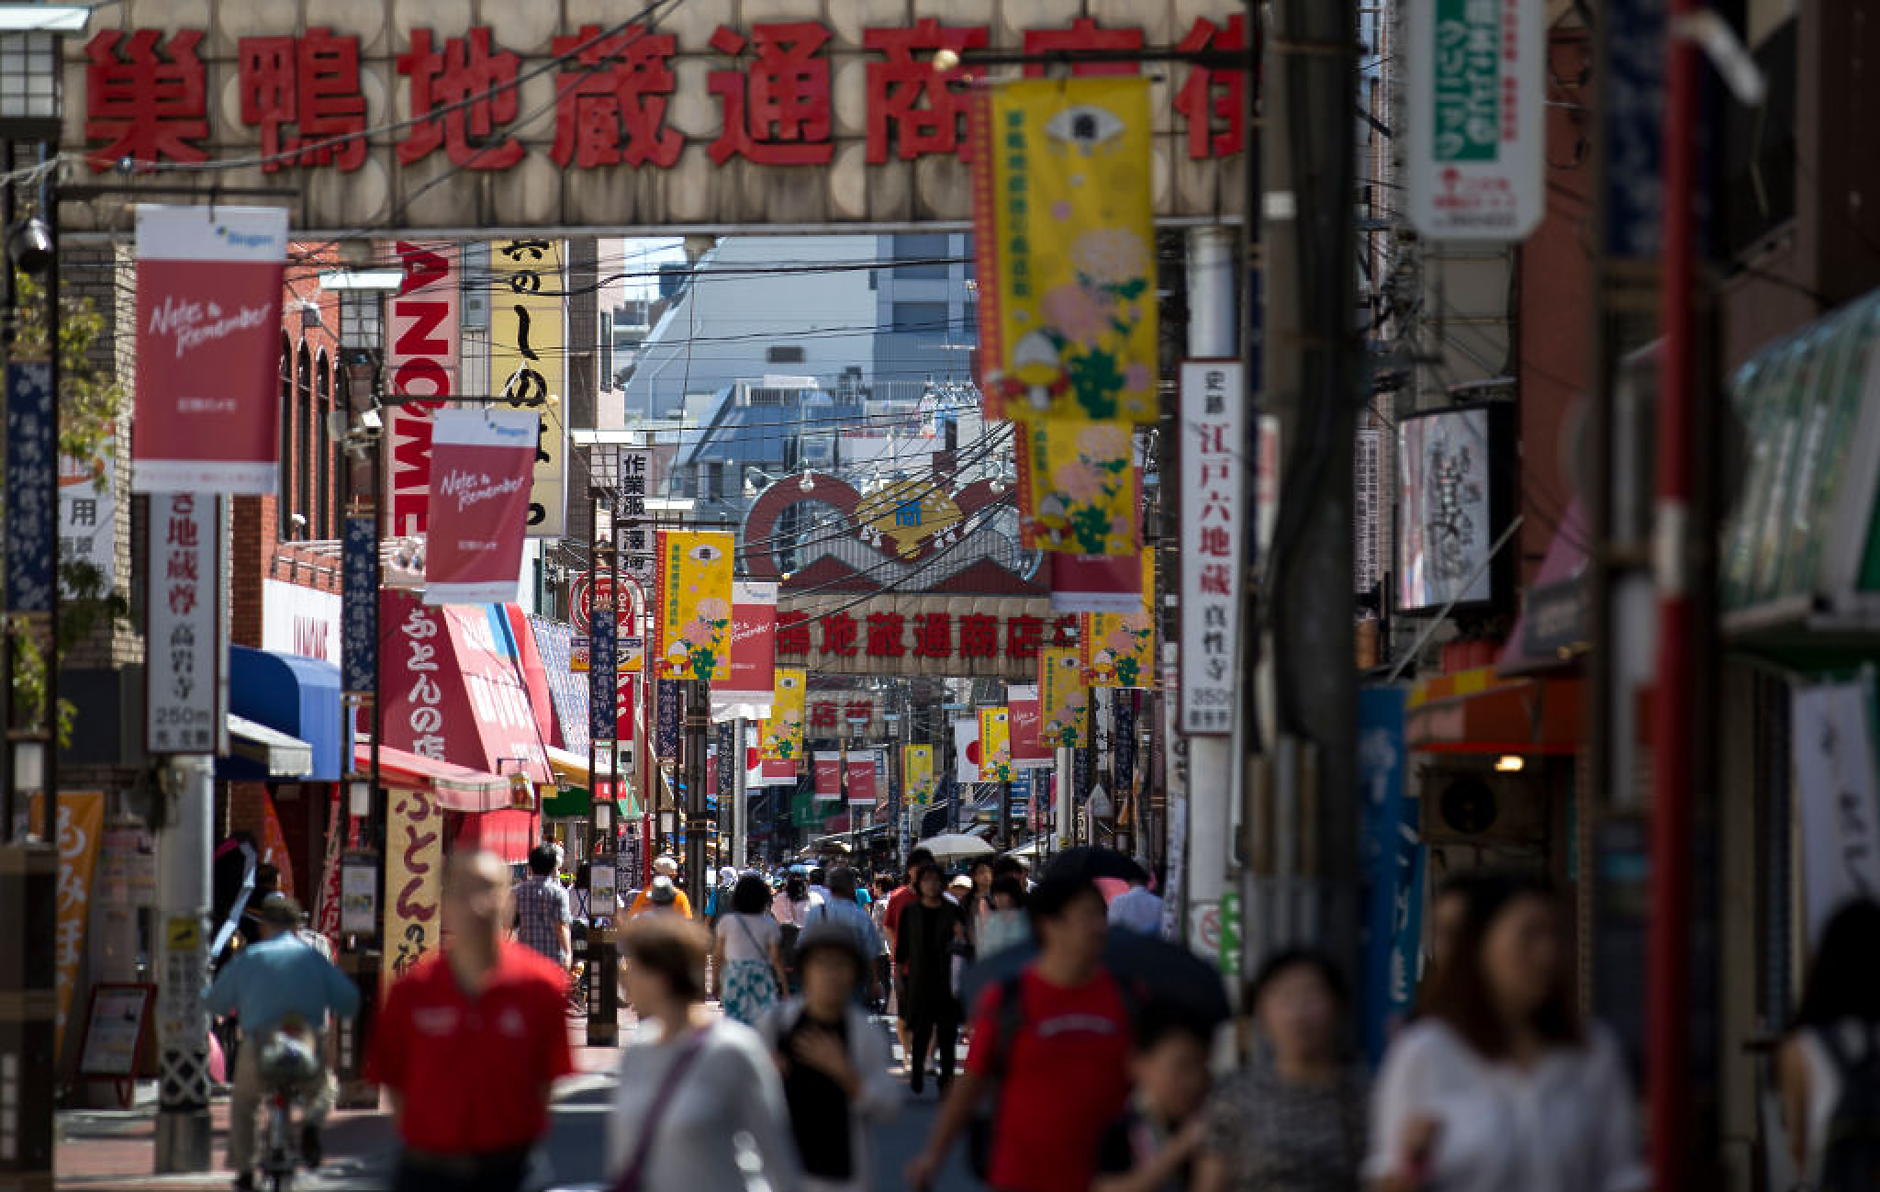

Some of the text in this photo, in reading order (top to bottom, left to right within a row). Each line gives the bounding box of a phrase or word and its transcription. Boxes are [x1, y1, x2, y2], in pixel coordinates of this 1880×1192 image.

[175, 302, 273, 358] Remember
[624, 454, 647, 515] 作業服
[1198, 422, 1232, 598] 江戸六地蔵
[170, 621, 195, 700] 高岩寺
[156, 707, 211, 725] 250m
